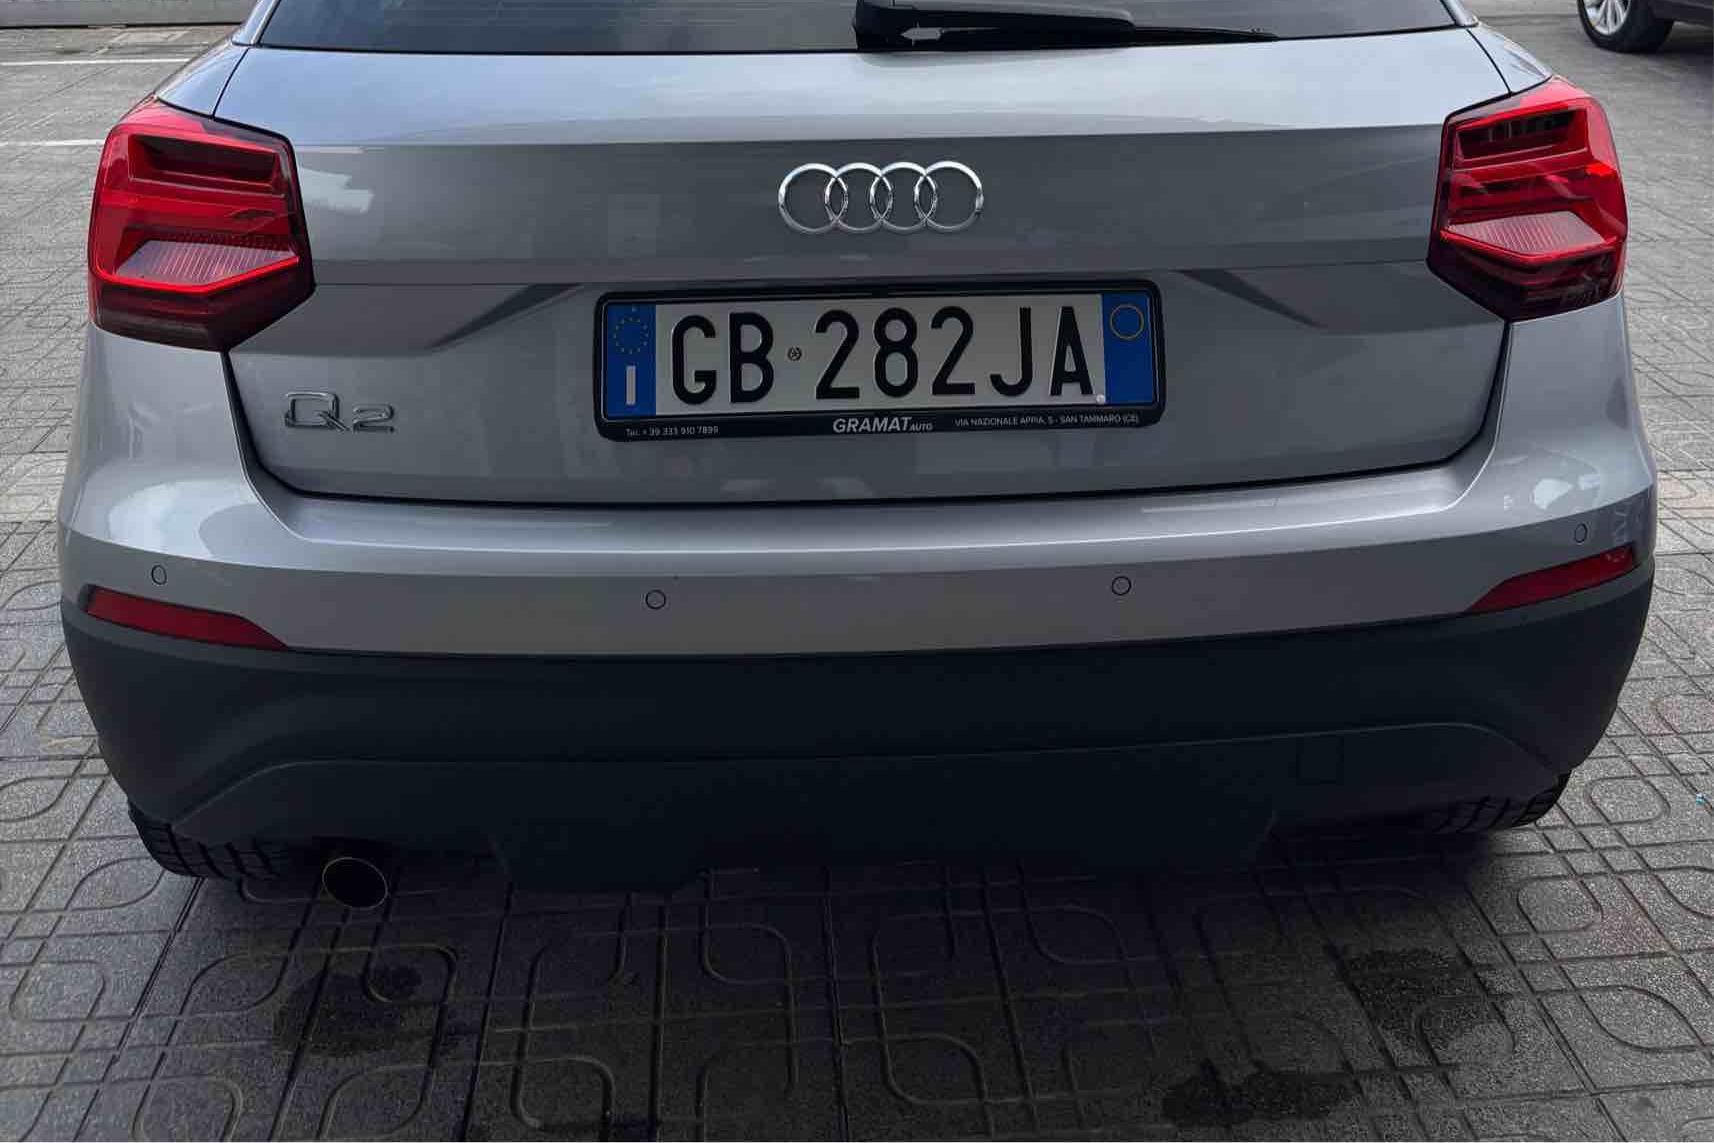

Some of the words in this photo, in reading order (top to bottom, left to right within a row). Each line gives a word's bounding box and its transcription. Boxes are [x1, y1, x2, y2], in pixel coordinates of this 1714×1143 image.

[671, 313, 774, 405] GB
[285, 391, 395, 432] Q2
[833, 417, 913, 433] GRAMAT
